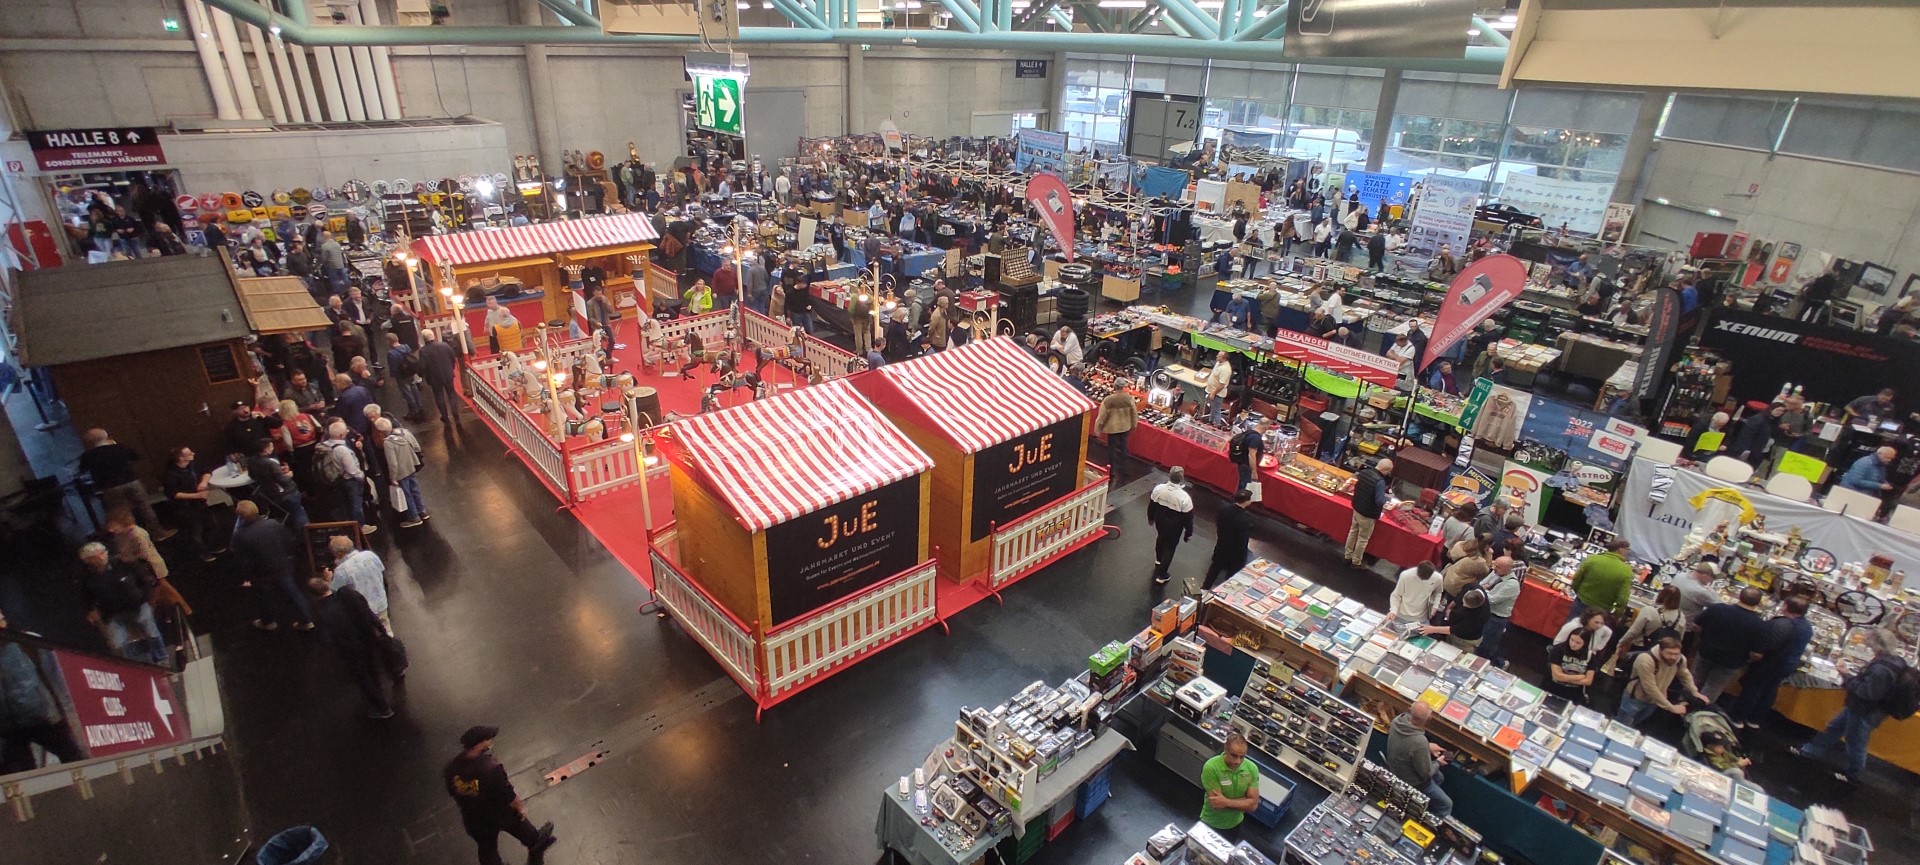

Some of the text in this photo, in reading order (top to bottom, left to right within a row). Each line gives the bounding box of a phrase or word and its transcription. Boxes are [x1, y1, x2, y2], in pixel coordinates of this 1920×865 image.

[1176, 109, 1195, 130] 7.2
[46, 131, 120, 147] HALLE 8
[46, 155, 158, 168] SONDERSCHAU HÄNDLER
[71, 150, 123, 159] TEILEMARKT
[1363, 179, 1390, 189] STATT
[1713, 319, 1800, 345] XENUM
[1278, 329, 1328, 349] ALEXANDER
[1335, 346, 1367, 361] OLDTIMER
[1367, 355, 1399, 370] ELEKTRIK
[1476, 381, 1491, 392] MILE
[1568, 416, 1594, 430] 2022
[1030, 469, 1043, 480] UND
[1044, 461, 1064, 474] EVENT
[1576, 472, 1610, 481] ASTROL
[799, 530, 896, 574] JAHRMARKT UND EVENT
